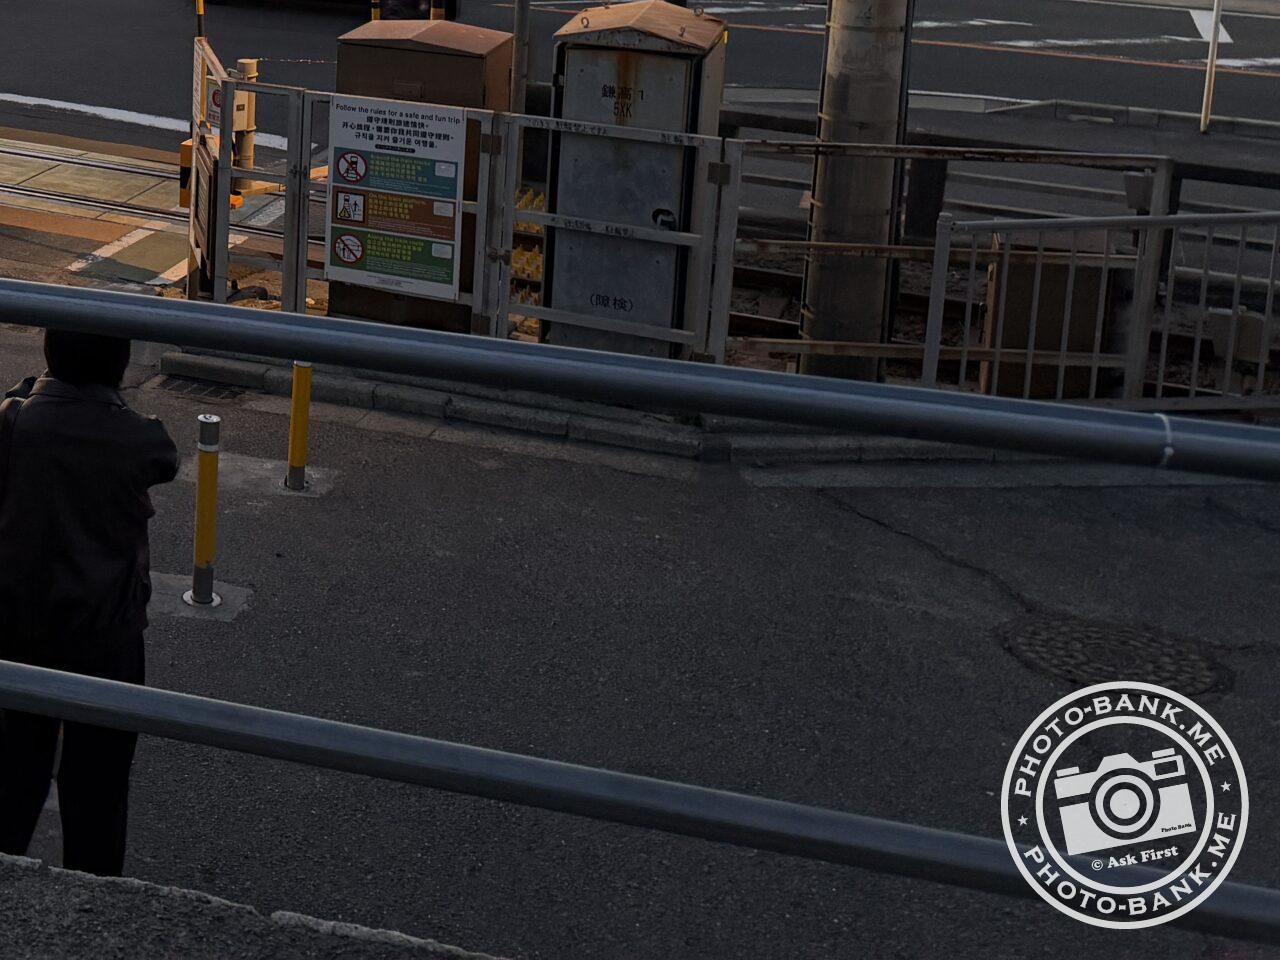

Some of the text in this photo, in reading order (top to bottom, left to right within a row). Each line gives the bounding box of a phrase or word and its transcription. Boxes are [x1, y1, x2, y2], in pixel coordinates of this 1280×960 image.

[335, 103, 357, 113] Follow
[358, 106, 369, 114] the
[370, 108, 387, 116] rules
[405, 111, 420, 120] safe
[421, 113, 434, 121] and
[435, 114, 447, 122] fun
[448, 115, 461, 125] trip
